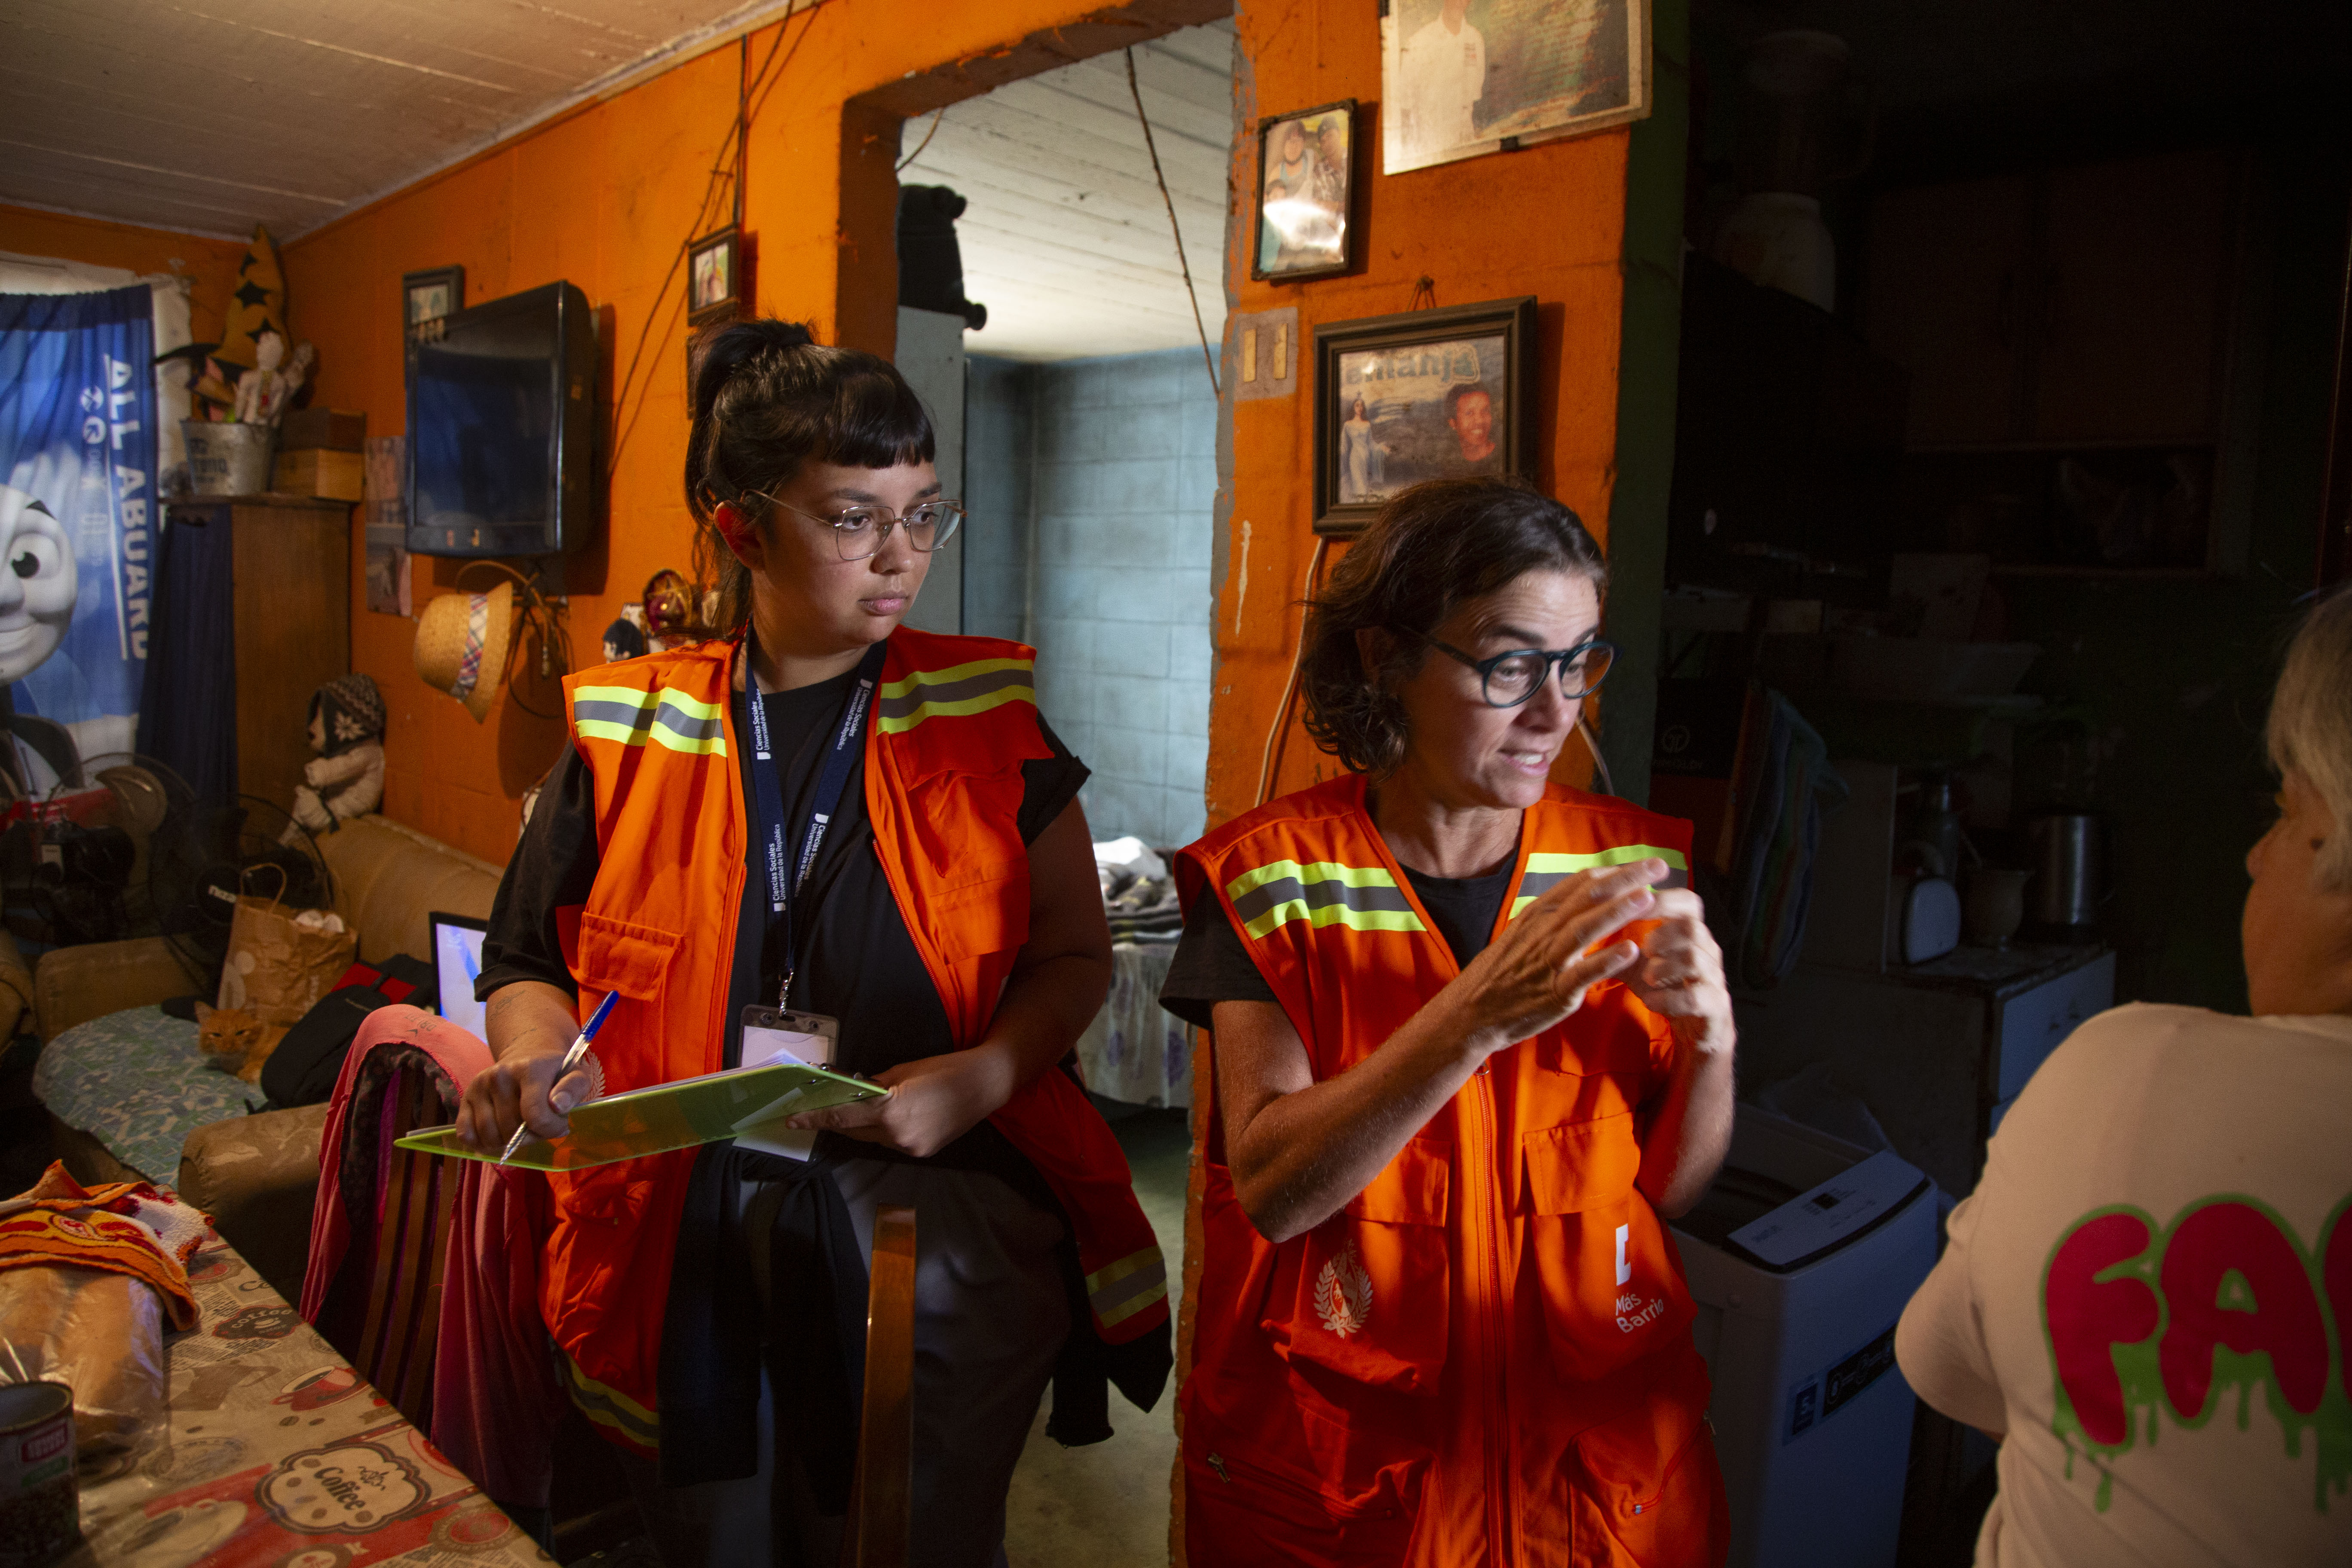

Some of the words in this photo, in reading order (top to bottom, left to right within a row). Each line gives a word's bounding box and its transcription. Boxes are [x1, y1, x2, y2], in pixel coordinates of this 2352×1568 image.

[109, 359, 141, 450] ALL
[751, 701, 760, 725] Sociales
[848, 686, 863, 716] Universidad
[857, 689, 871, 714] Ciencias
[754, 725, 763, 750] Ciencias
[760, 721, 770, 751] Universidad
[848, 713, 862, 738] Sociales
[774, 824, 783, 851] República
[804, 823, 819, 856] Universidad
[812, 824, 826, 852] Ciencias
[768, 843, 777, 872] Sociales
[803, 852, 818, 880] Sociales
[770, 872, 780, 901] Ciencias
[777, 866, 787, 900] Universidad
[1615, 1292, 1642, 1317] Más
[1616, 1298, 1664, 1334] Barrio
[2040, 1193, 2352, 1457] FA
[314, 1466, 366, 1510] Coffee
